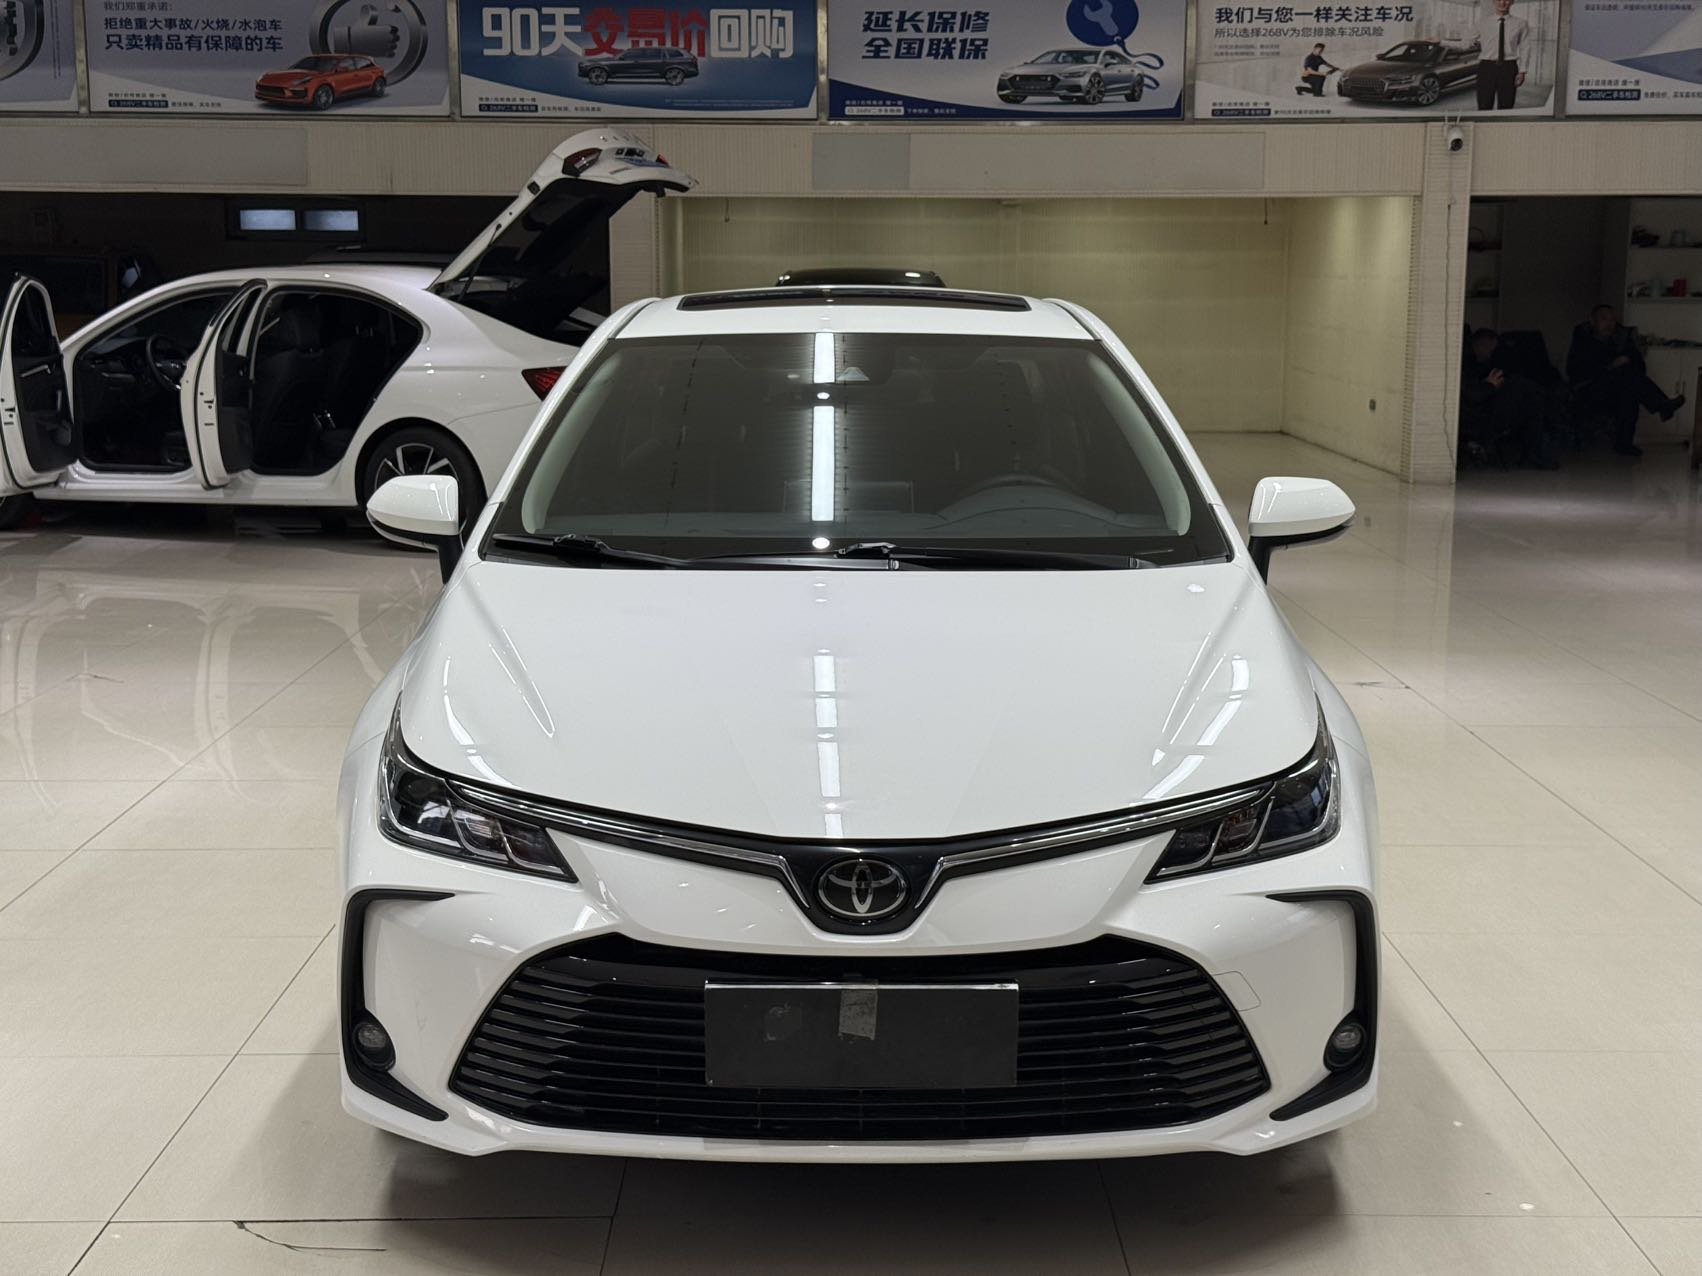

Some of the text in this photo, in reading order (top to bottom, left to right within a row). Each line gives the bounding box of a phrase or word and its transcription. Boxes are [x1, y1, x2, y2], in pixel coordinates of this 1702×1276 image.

[862, 10, 990, 33] 延长保修
[1215, 6, 1414, 23] 我们与您一样关注车况
[104, 17, 282, 31] 拒绝重大事故/火烧/水泡车
[482, 7, 794, 58] 90天交易价回购
[1214, 26, 1384, 38] 所以选择268V为您排除车况风险
[105, 34, 283, 51] 只卖精品有保障的车
[862, 37, 990, 60] 全国联保
